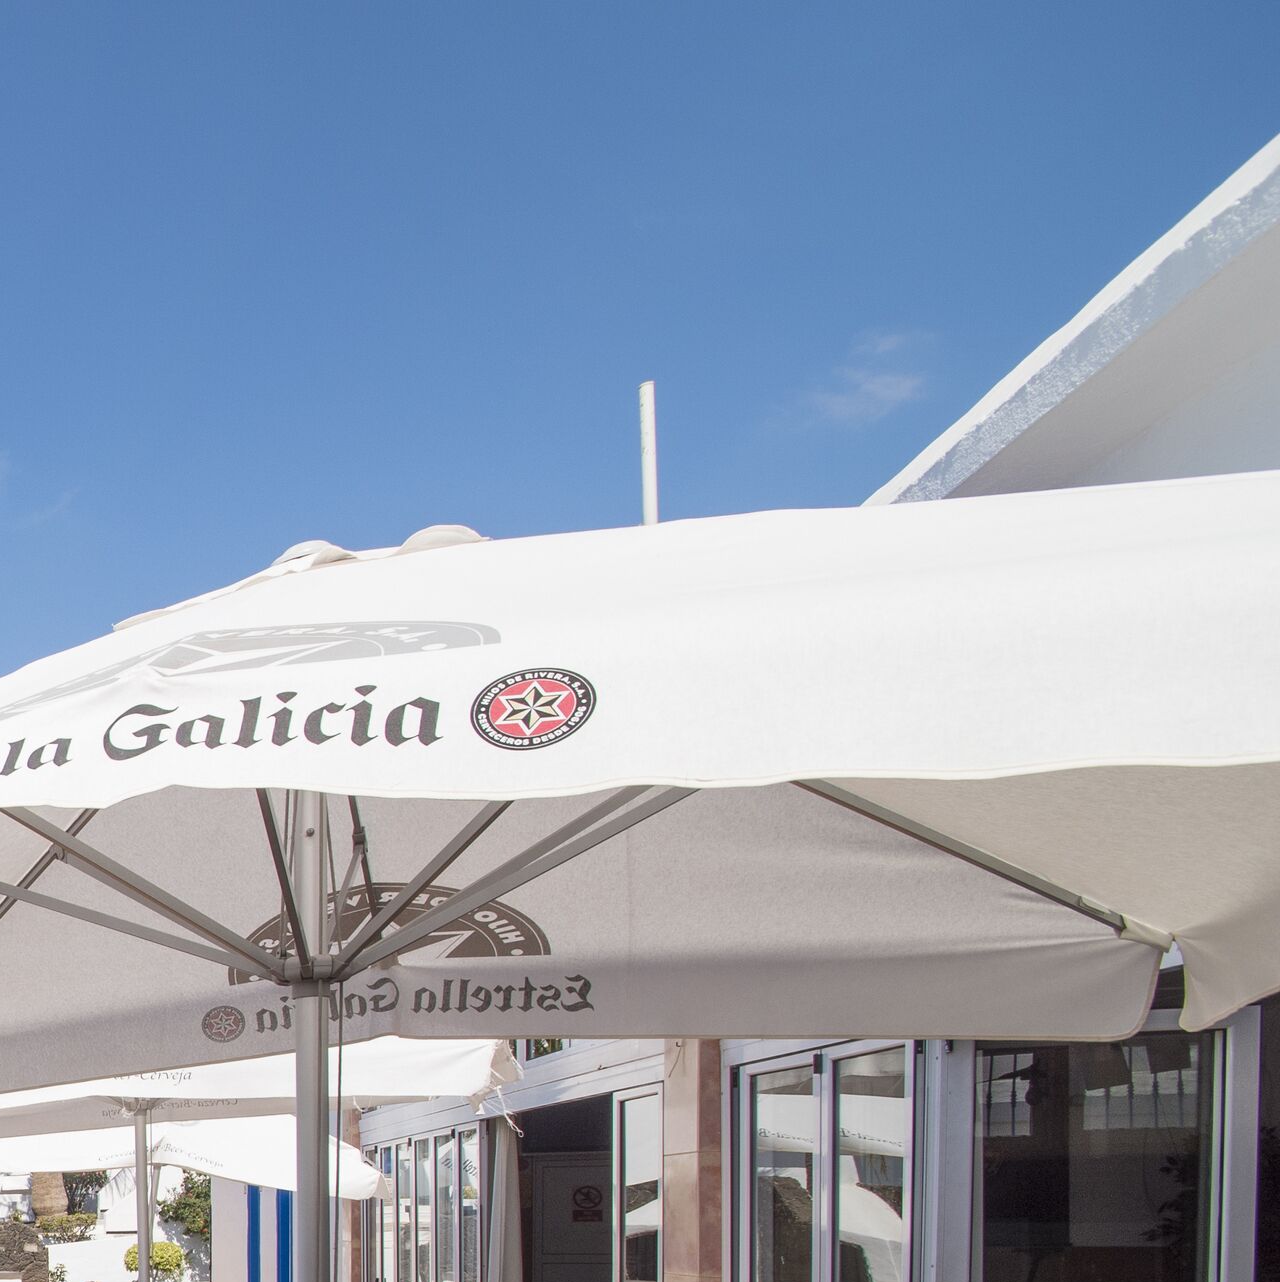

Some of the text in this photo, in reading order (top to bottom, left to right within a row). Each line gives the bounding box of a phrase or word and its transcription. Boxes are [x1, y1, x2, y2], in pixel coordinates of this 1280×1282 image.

[481, 682, 506, 706] HIJOS
[506, 675, 523, 685] DE
[103, 684, 444, 761] Galicia
[477, 713, 531, 746] CERVECEROS
[532, 725, 571, 745] DESDE
